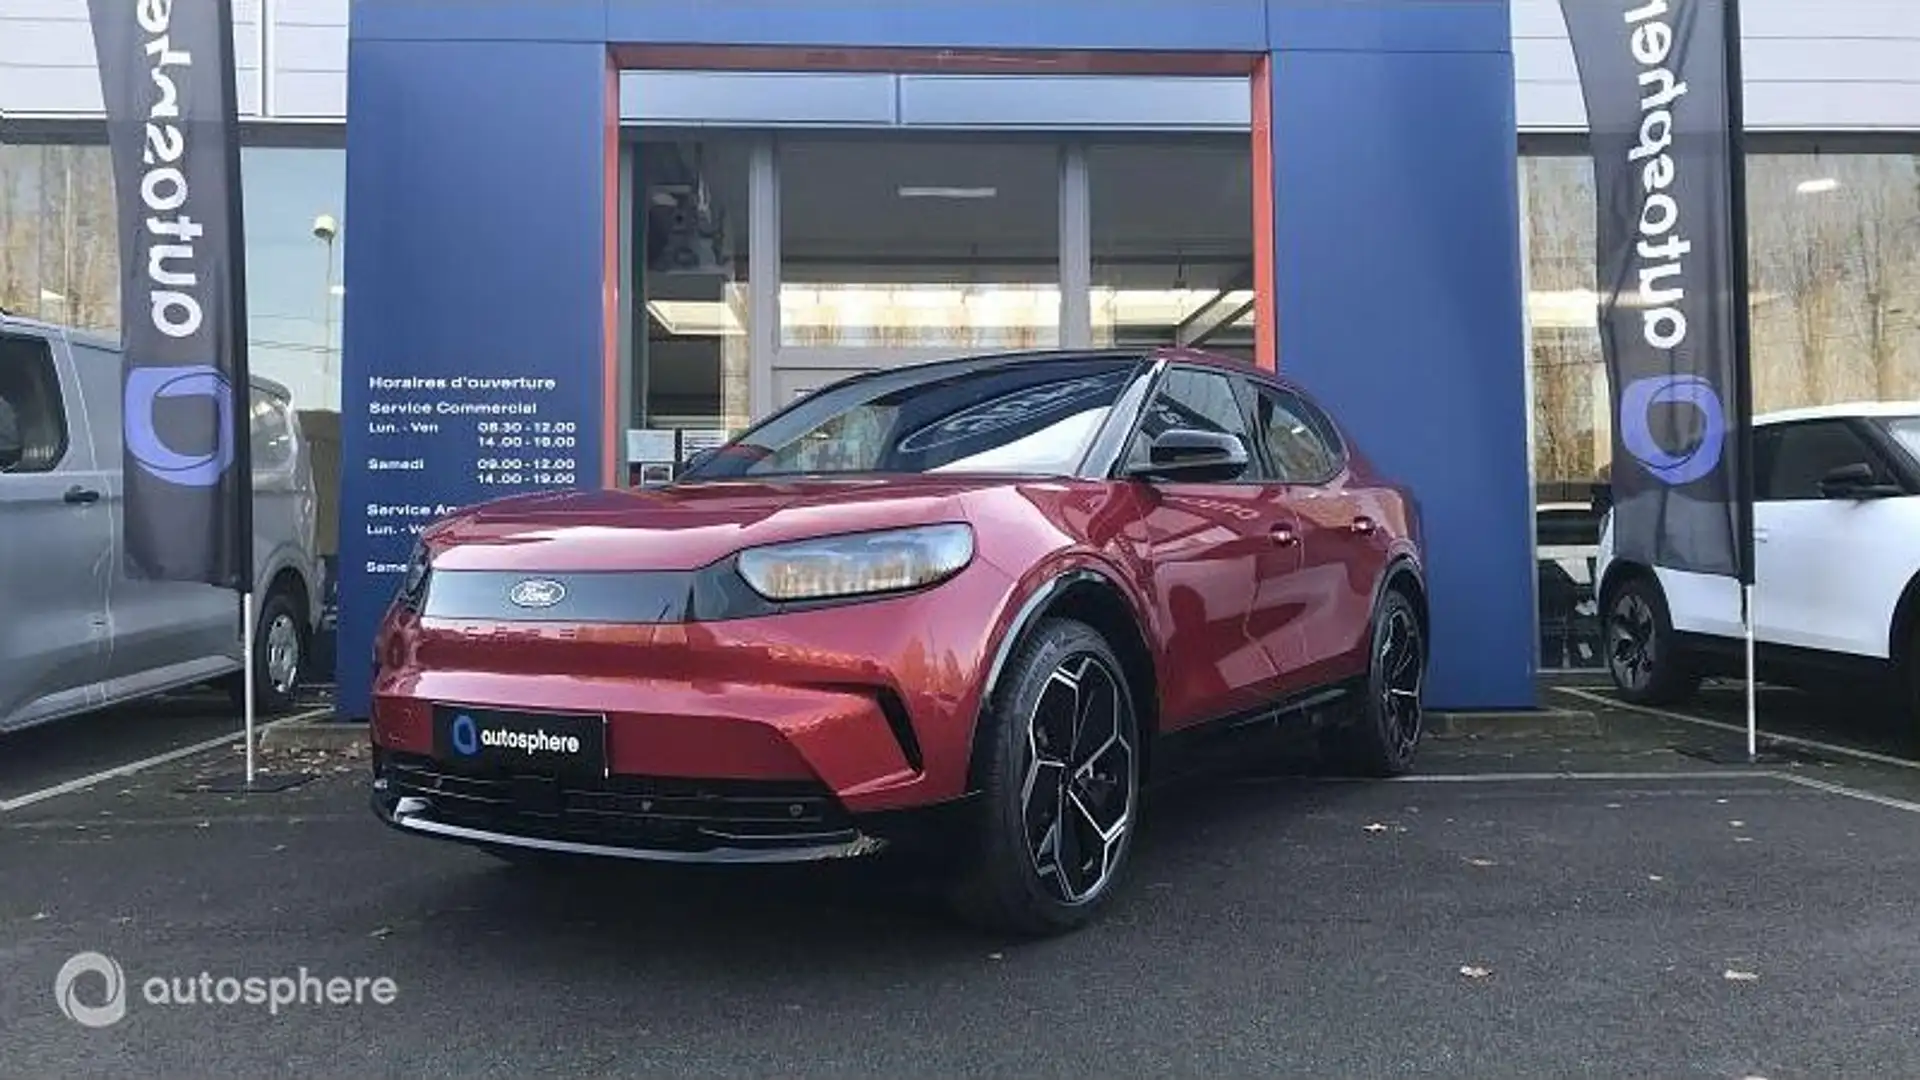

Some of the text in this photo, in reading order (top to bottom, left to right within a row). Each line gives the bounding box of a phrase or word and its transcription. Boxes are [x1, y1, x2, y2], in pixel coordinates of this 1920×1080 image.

[369, 377, 556, 389] Horaires d'ouverture
[369, 401, 537, 414] Service Commercial
[369, 422, 399, 433] Lun.
[410, 422, 439, 433] Ven
[534, 422, 576, 433] 12.00
[479, 437, 522, 448] 14.00
[368, 458, 424, 470] Samedi
[477, 458, 522, 470] 09.00
[534, 458, 575, 470] 12.00
[478, 473, 522, 484] 14.00
[367, 504, 431, 515] Service
[367, 524, 397, 535] Lun.
[480, 729, 580, 755] autosphere
